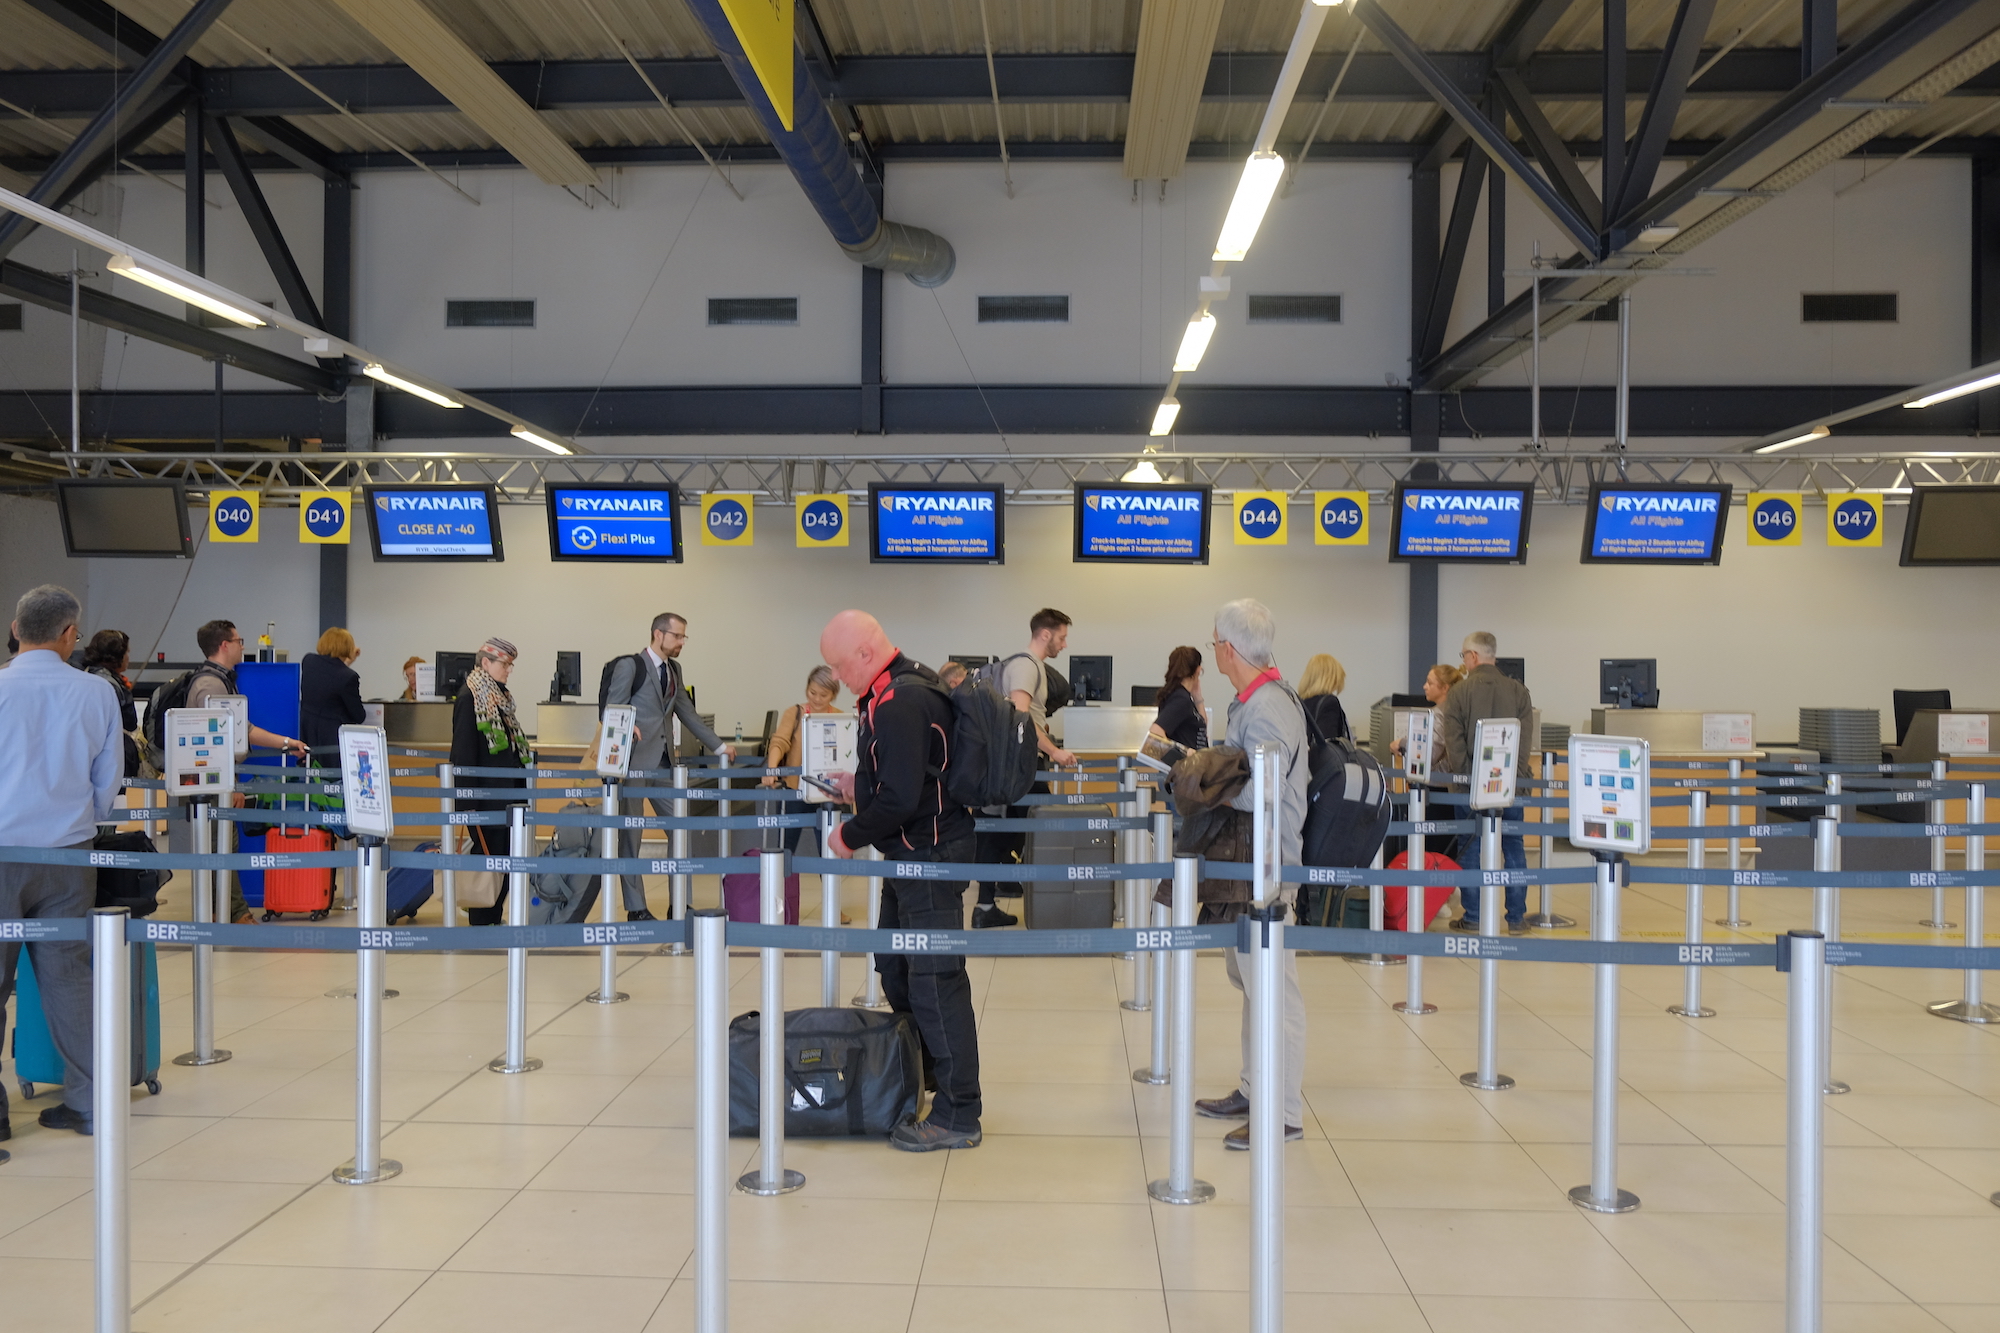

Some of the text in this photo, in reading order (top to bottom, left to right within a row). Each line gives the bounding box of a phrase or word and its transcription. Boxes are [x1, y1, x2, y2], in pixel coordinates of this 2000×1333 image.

[390, 497, 485, 510] RYANAIR
[576, 498, 663, 512] RYANAIR
[895, 497, 993, 511] RYANAIR
[1101, 496, 1199, 511] RYANAIR
[1420, 496, 1519, 511] RYANAIR
[1616, 497, 1716, 512] RYANAIR
[218, 509, 250, 522] D40
[309, 509, 339, 523] D41
[710, 512, 743, 526] D42
[805, 512, 838, 527] D43
[912, 515, 963, 526] All Flights
[1117, 515, 1169, 526] All Flights
[1243, 510, 1278, 524] D44
[1324, 510, 1358, 524] D45
[1436, 514, 1488, 526] All Flights
[1631, 516, 1684, 527] All Flights
[1757, 511, 1792, 525] D46
[1837, 511, 1872, 526] D47
[398, 524, 475, 534] CLOSE AT -40
[601, 534, 655, 544] Flexi Plus
[122, 778, 132, 786] ER
[1453, 775, 1467, 783] BER
[1549, 781, 1563, 789] BER
[1683, 779, 1698, 787] BER
[1779, 778, 1794, 786] BER
[1917, 780, 1932, 788] BER
[324, 785, 340, 793] BER
[457, 789, 473, 797] BER
[565, 789, 582, 797] BER
[687, 790, 703, 798] BER
[1068, 795, 1084, 803] BER
[1780, 797, 1798, 805] BER
[1897, 792, 1914, 801] BER
[131, 810, 149, 819] BER
[323, 814, 341, 823] BER
[449, 814, 468, 823] BER
[625, 818, 644, 827] BER
[758, 817, 777, 827] BER
[1088, 819, 1108, 829] BER
[1415, 823, 1435, 833] BER
[1750, 826, 1770, 836] BER
[1925, 825, 1947, 836] BER
[90, 853, 114, 865] BER
[251, 855, 275, 868] BER
[486, 858, 510, 870] BER
[652, 861, 676, 873] BER
[897, 864, 922, 876] BER
[1068, 867, 1093, 879] BER
[1309, 869, 1335, 882] BER
[1483, 872, 1509, 884] BER
[1734, 872, 1760, 885] BER
[1910, 873, 1936, 886] BER
[147, 924, 178, 939] BER
[583, 927, 617, 943] BER
[360, 931, 392, 947] BER
[892, 934, 928, 950] BER
[1136, 931, 1172, 948] BER
[1445, 937, 1480, 955] BER
[1679, 946, 1713, 963] BER
